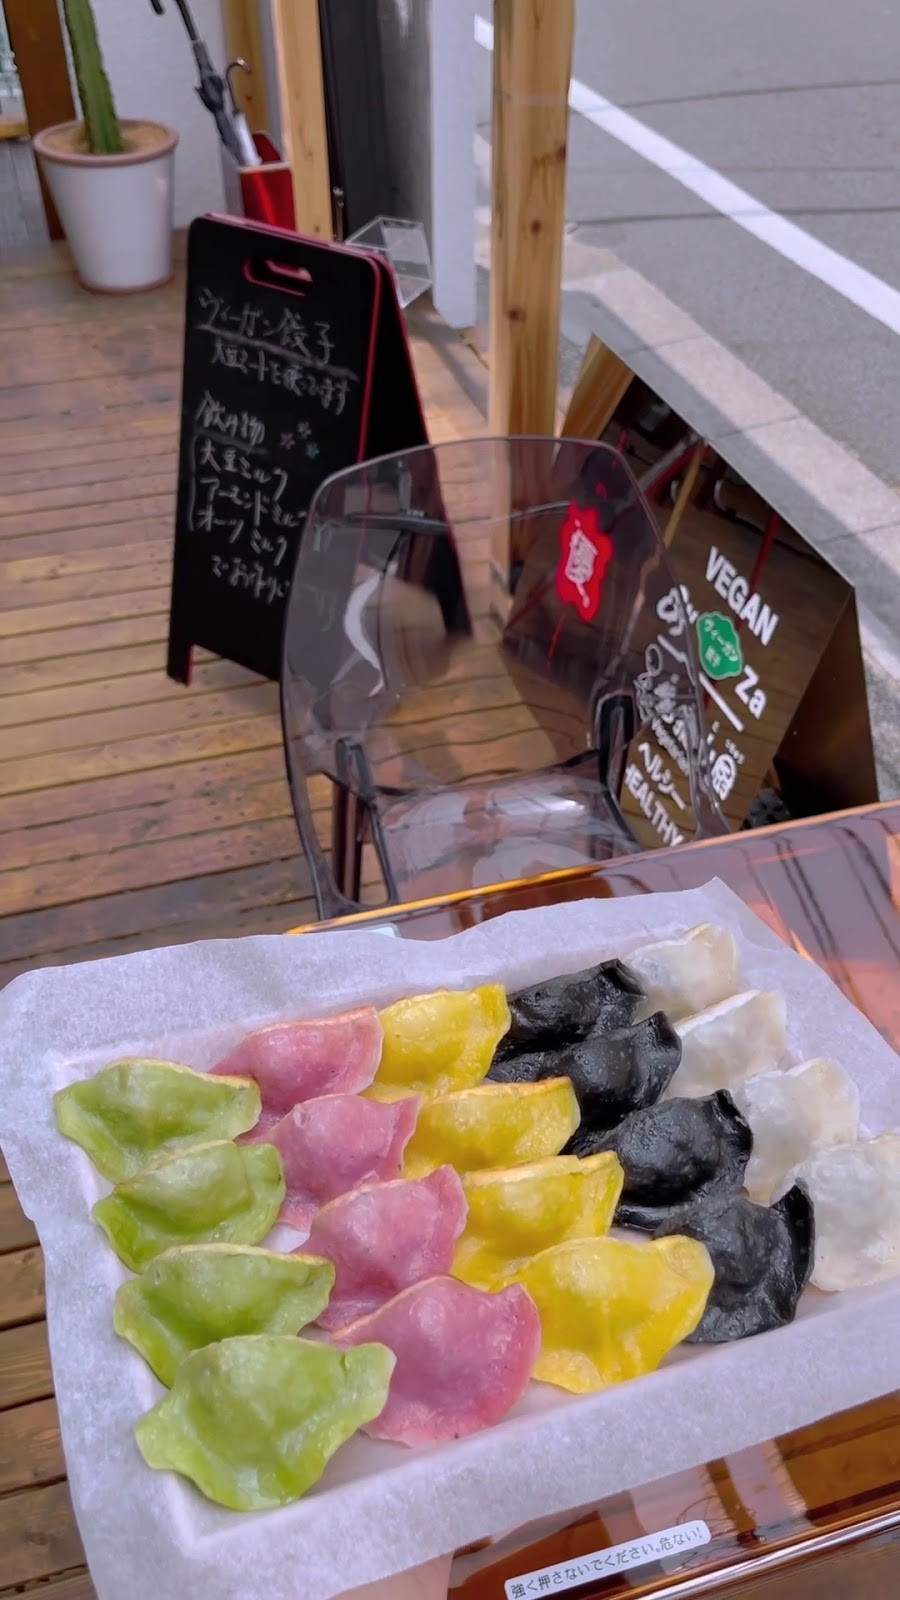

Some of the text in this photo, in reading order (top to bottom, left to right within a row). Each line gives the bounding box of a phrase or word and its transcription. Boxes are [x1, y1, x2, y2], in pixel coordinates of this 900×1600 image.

[705, 545, 779, 647] VEGAN
[637, 742, 687, 811] ヘルシー
